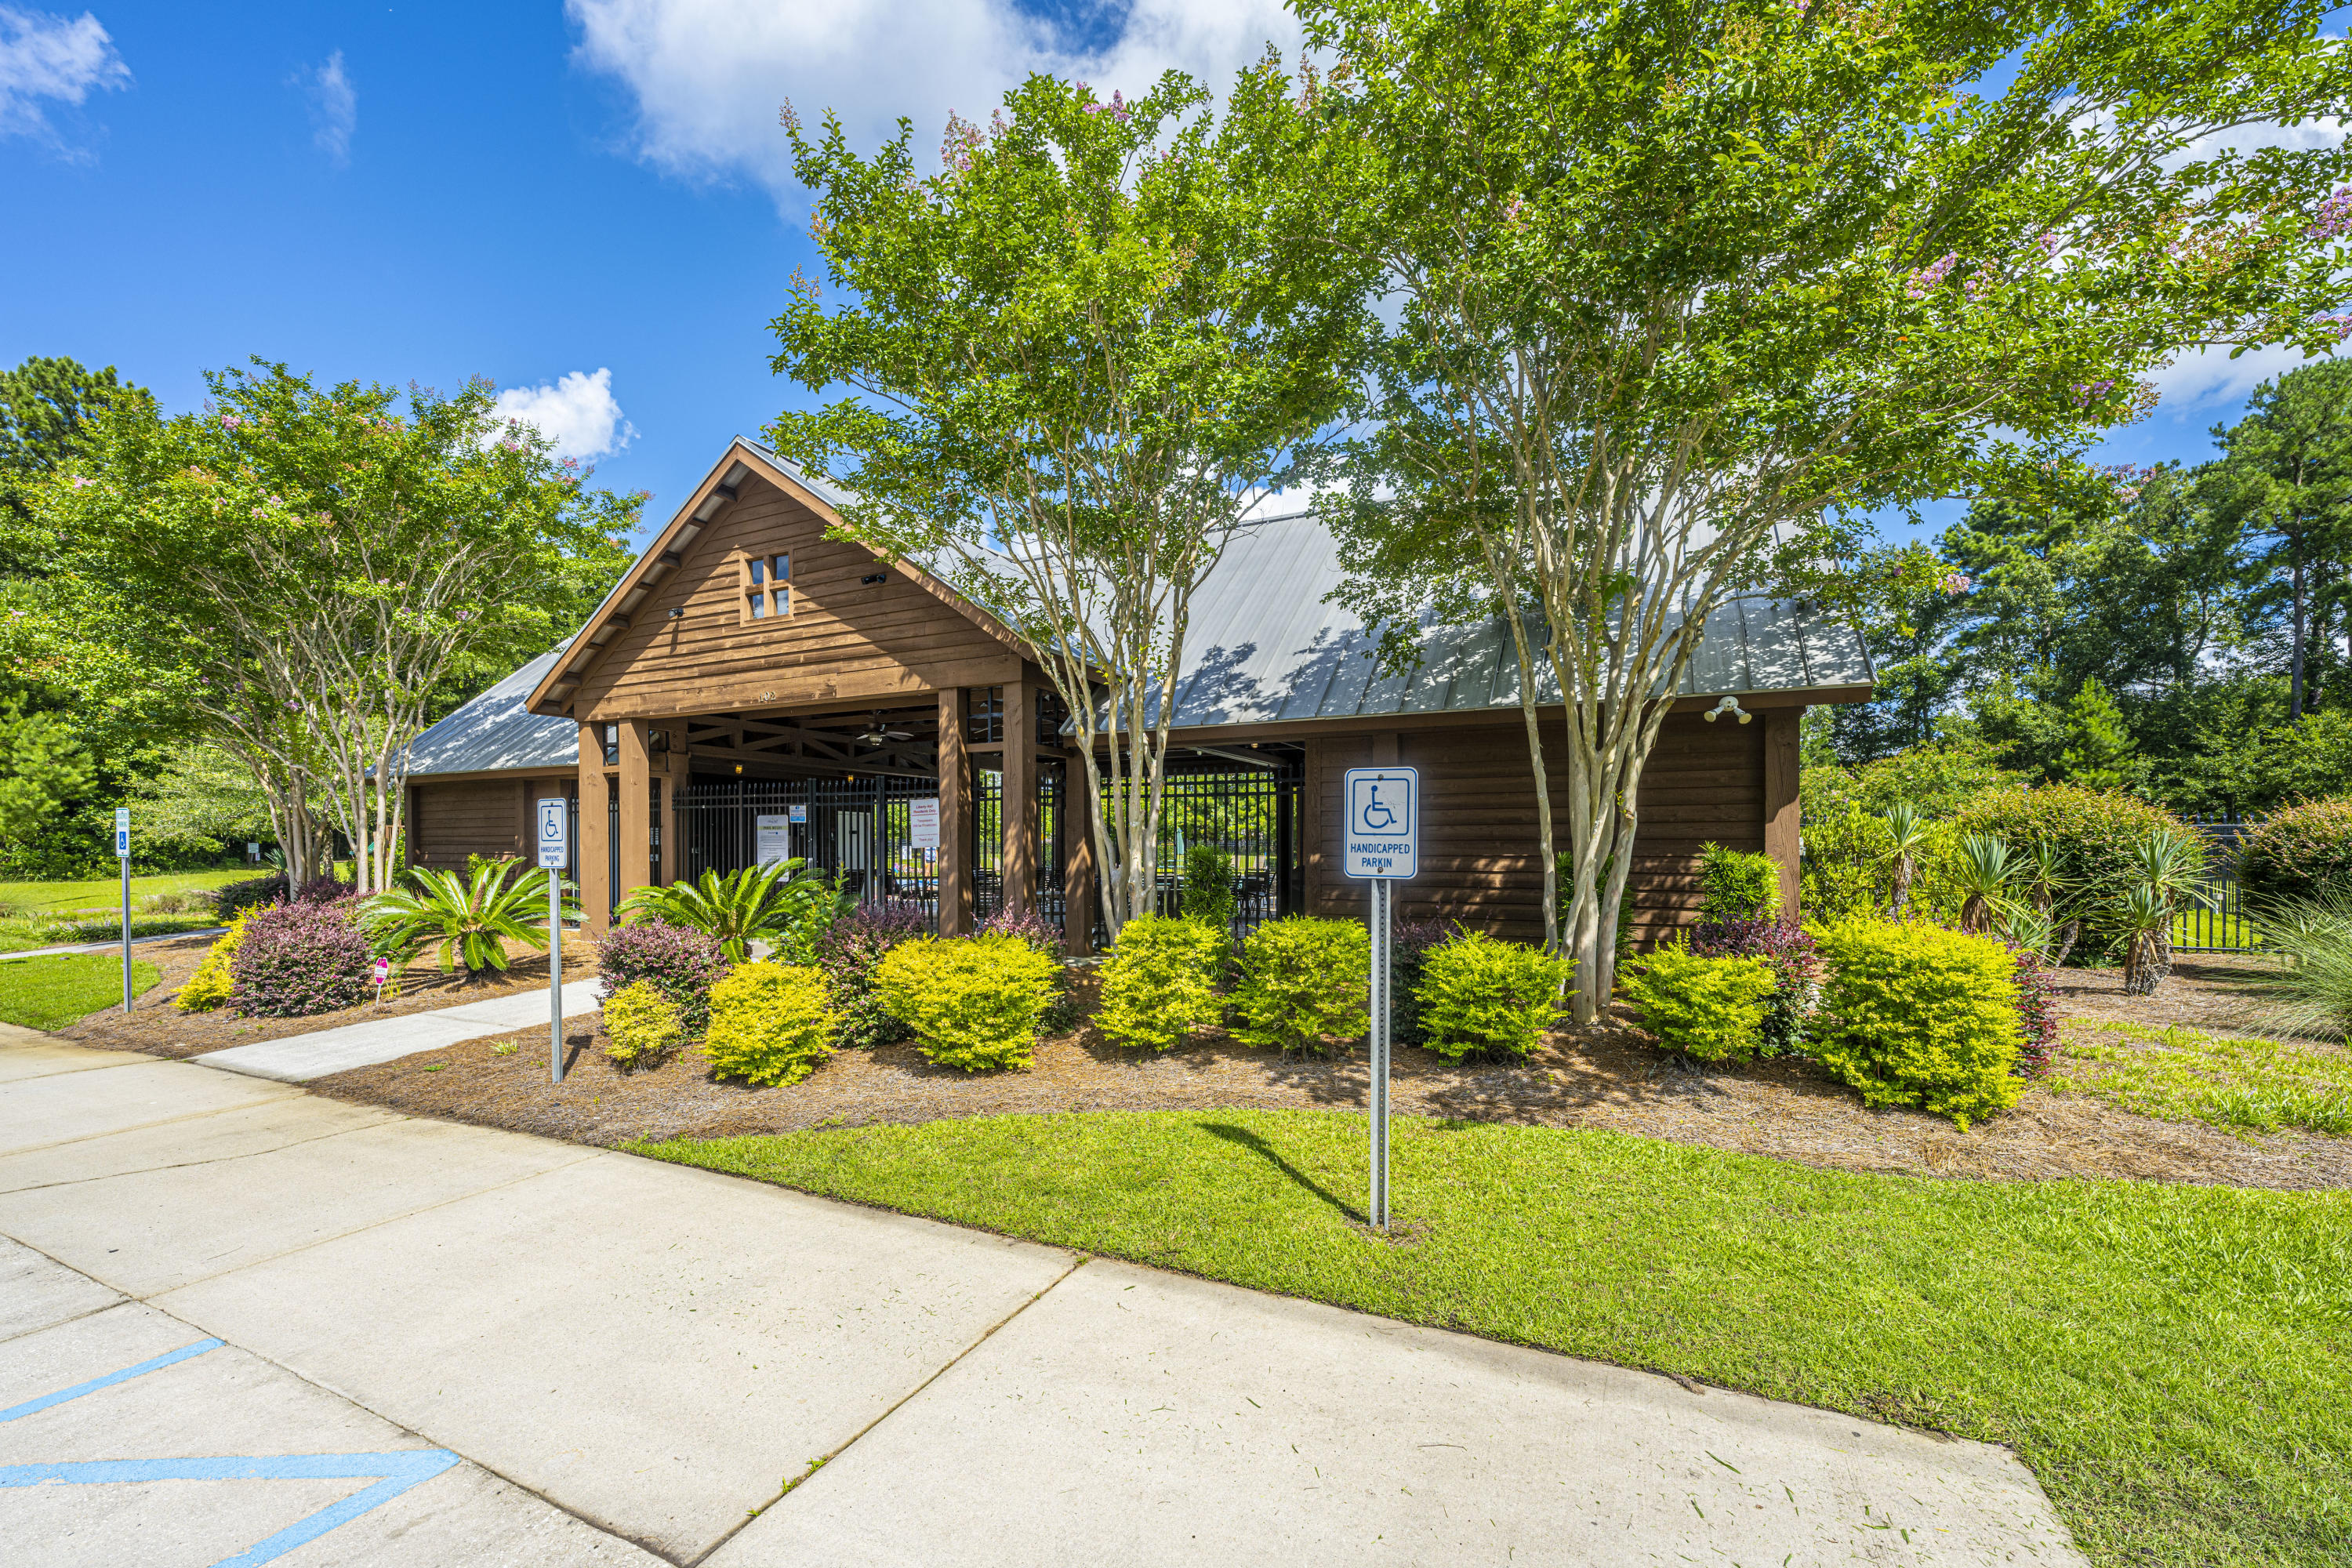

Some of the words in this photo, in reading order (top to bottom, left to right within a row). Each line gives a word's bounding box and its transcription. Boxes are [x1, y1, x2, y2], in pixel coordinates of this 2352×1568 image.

[759, 690, 776, 702] 102
[1350, 843, 1410, 854] HANDICAPPED
[1362, 857, 1392, 867] PARKIN
